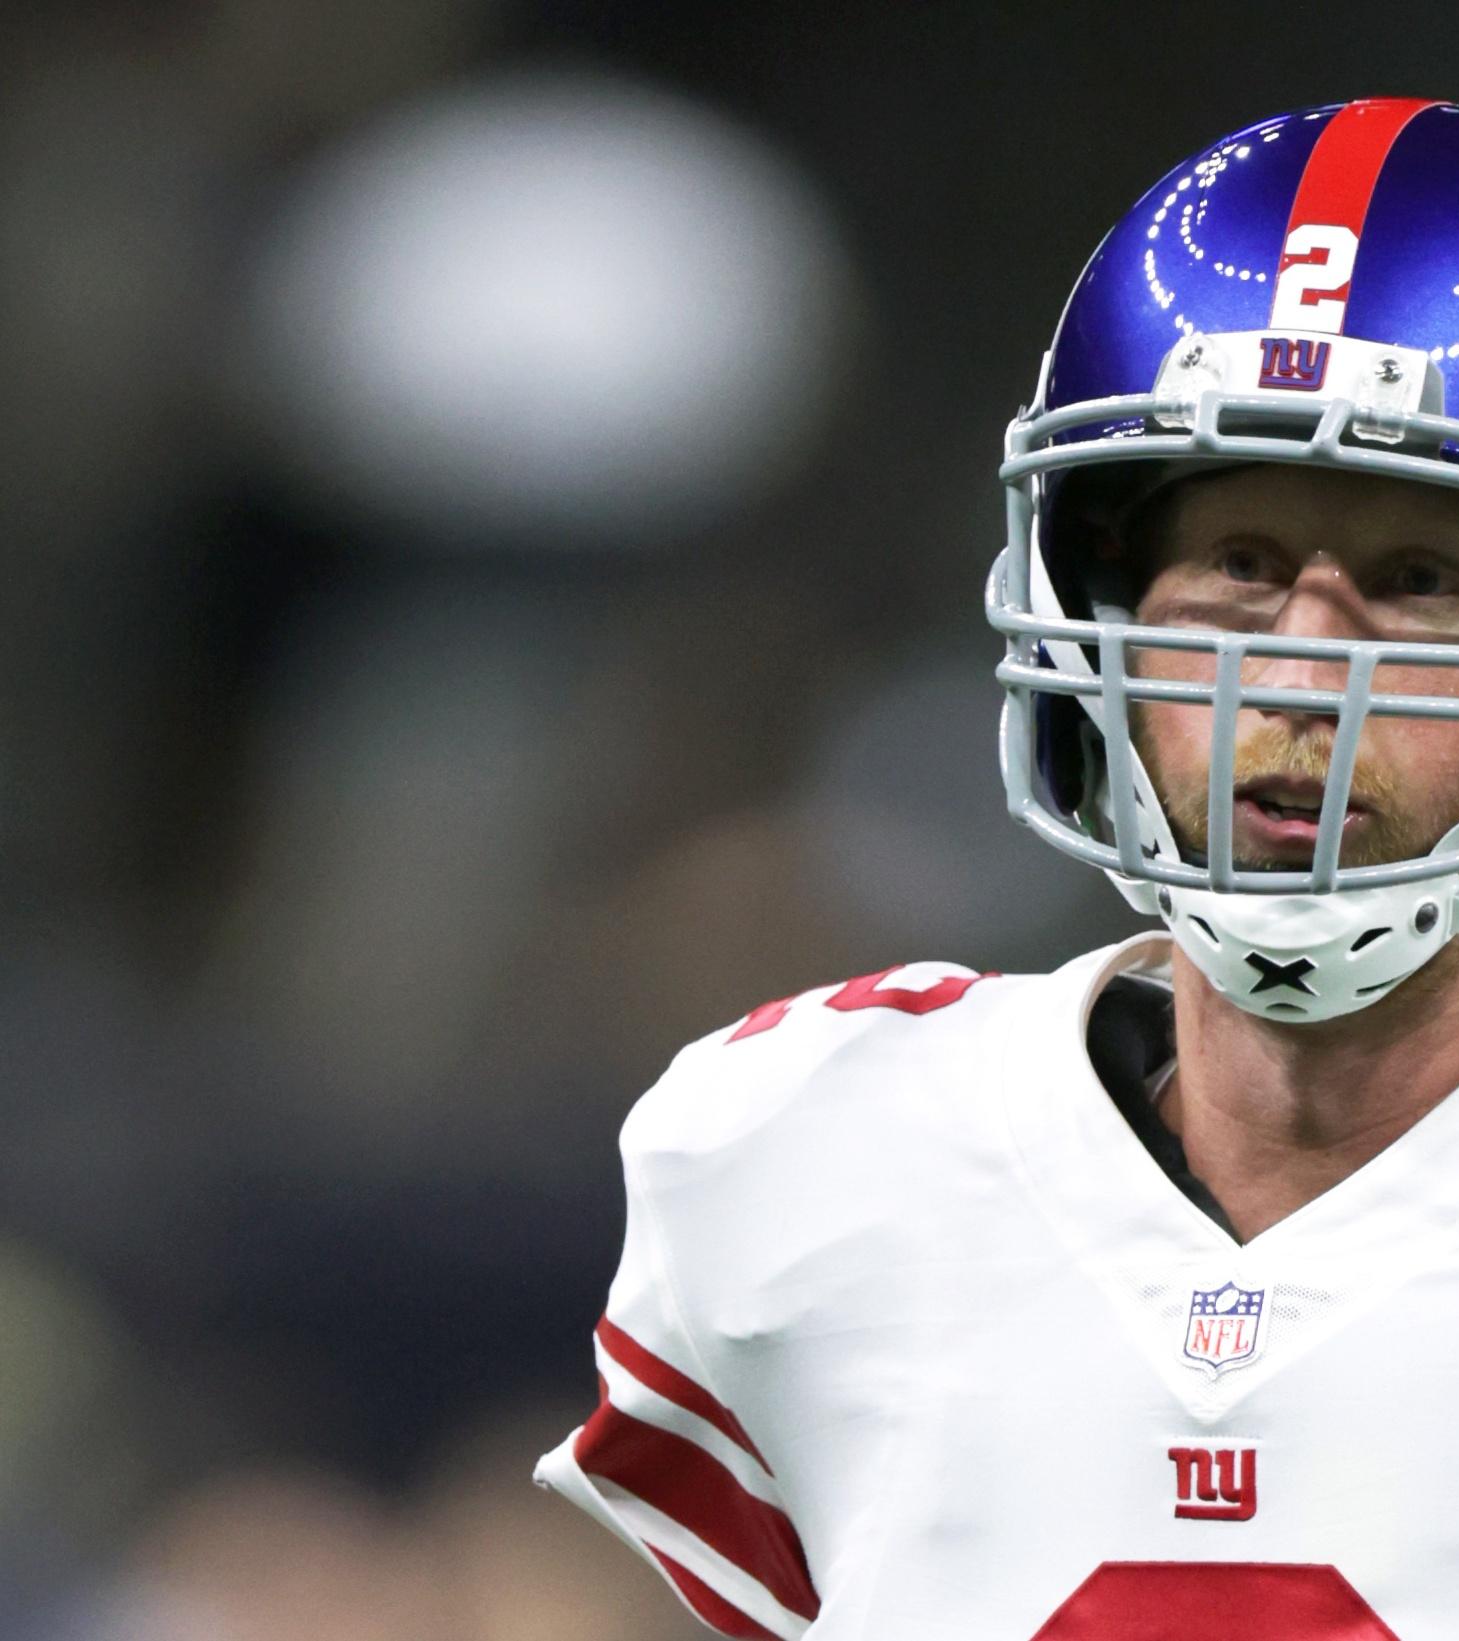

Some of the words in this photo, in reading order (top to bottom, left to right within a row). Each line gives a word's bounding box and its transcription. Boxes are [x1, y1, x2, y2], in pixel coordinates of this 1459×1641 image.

[1269, 224, 1359, 334] 2
[1258, 337, 1332, 392] ny
[1191, 1319, 1249, 1358] NFL
[1168, 1447, 1257, 1522] ny
